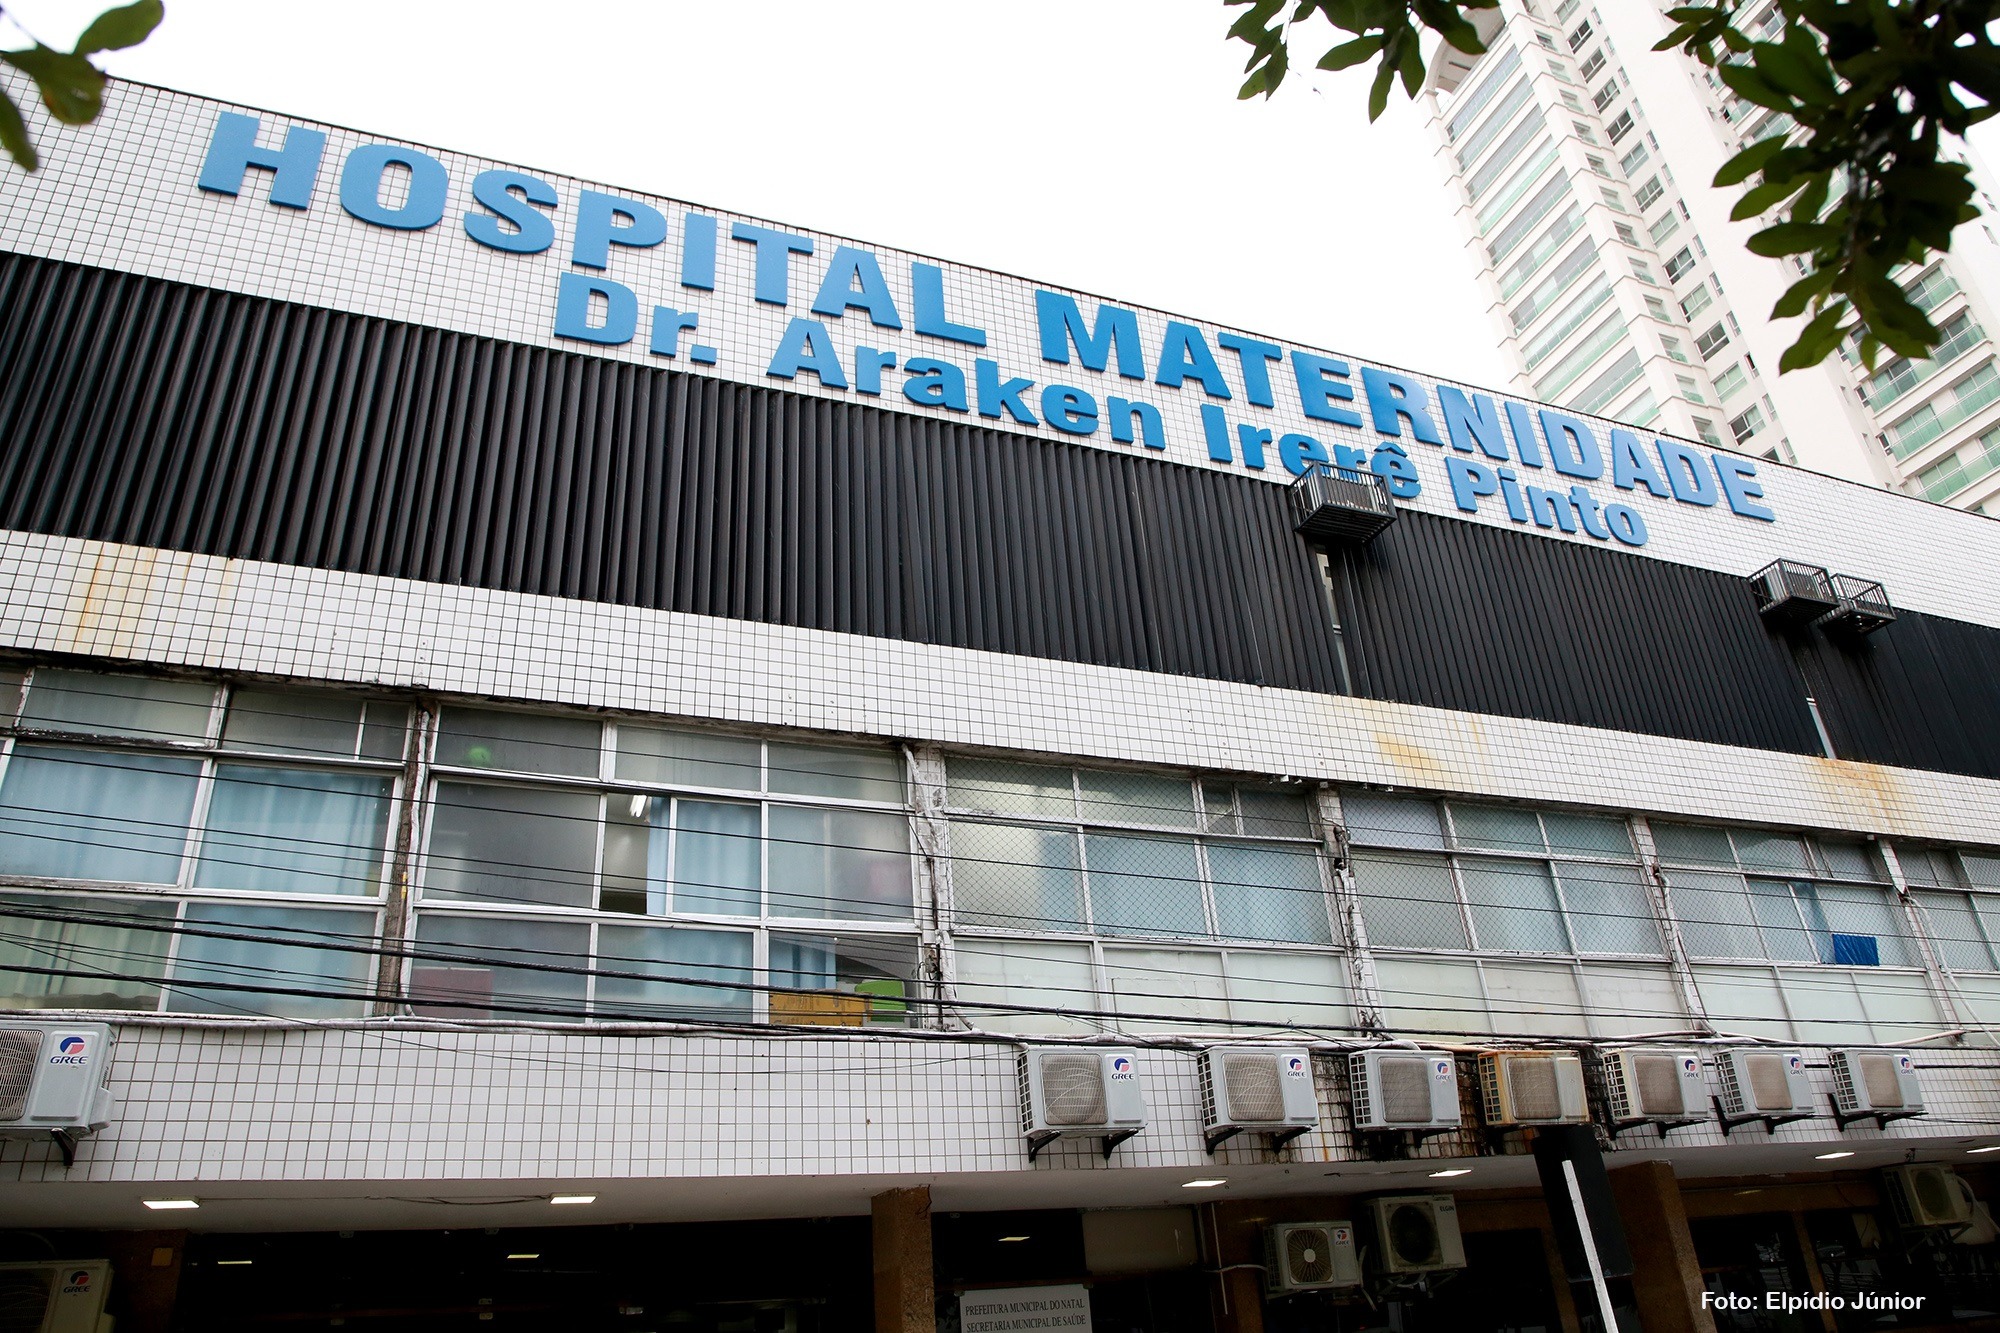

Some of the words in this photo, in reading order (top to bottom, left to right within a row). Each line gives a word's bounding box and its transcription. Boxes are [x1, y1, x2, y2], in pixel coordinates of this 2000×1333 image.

[198, 110, 988, 347] HOSPITAL
[1035, 289, 1775, 523] MATERNIDADE
[553, 272, 717, 366] Dr.
[765, 317, 1166, 451] Araken
[1200, 403, 1422, 499] Irerê
[1444, 456, 1648, 547] Pinto
[50, 1055, 88, 1065] GREE
[1287, 1070, 1306, 1078] GREE
[63, 1285, 91, 1294] GREE
[965, 1303, 1009, 1316] PREFEITURA
[1009, 1300, 1049, 1315] MUNICIPAL
[1050, 1300, 1061, 1311] DO
[1061, 1298, 1085, 1309] NATAL
[966, 1319, 1011, 1333] SECRETARIA
[1012, 1316, 1051, 1330] MUNICIPAL
[1052, 1315, 1062, 1327] DE
[1063, 1313, 1086, 1326] SAÚDE
